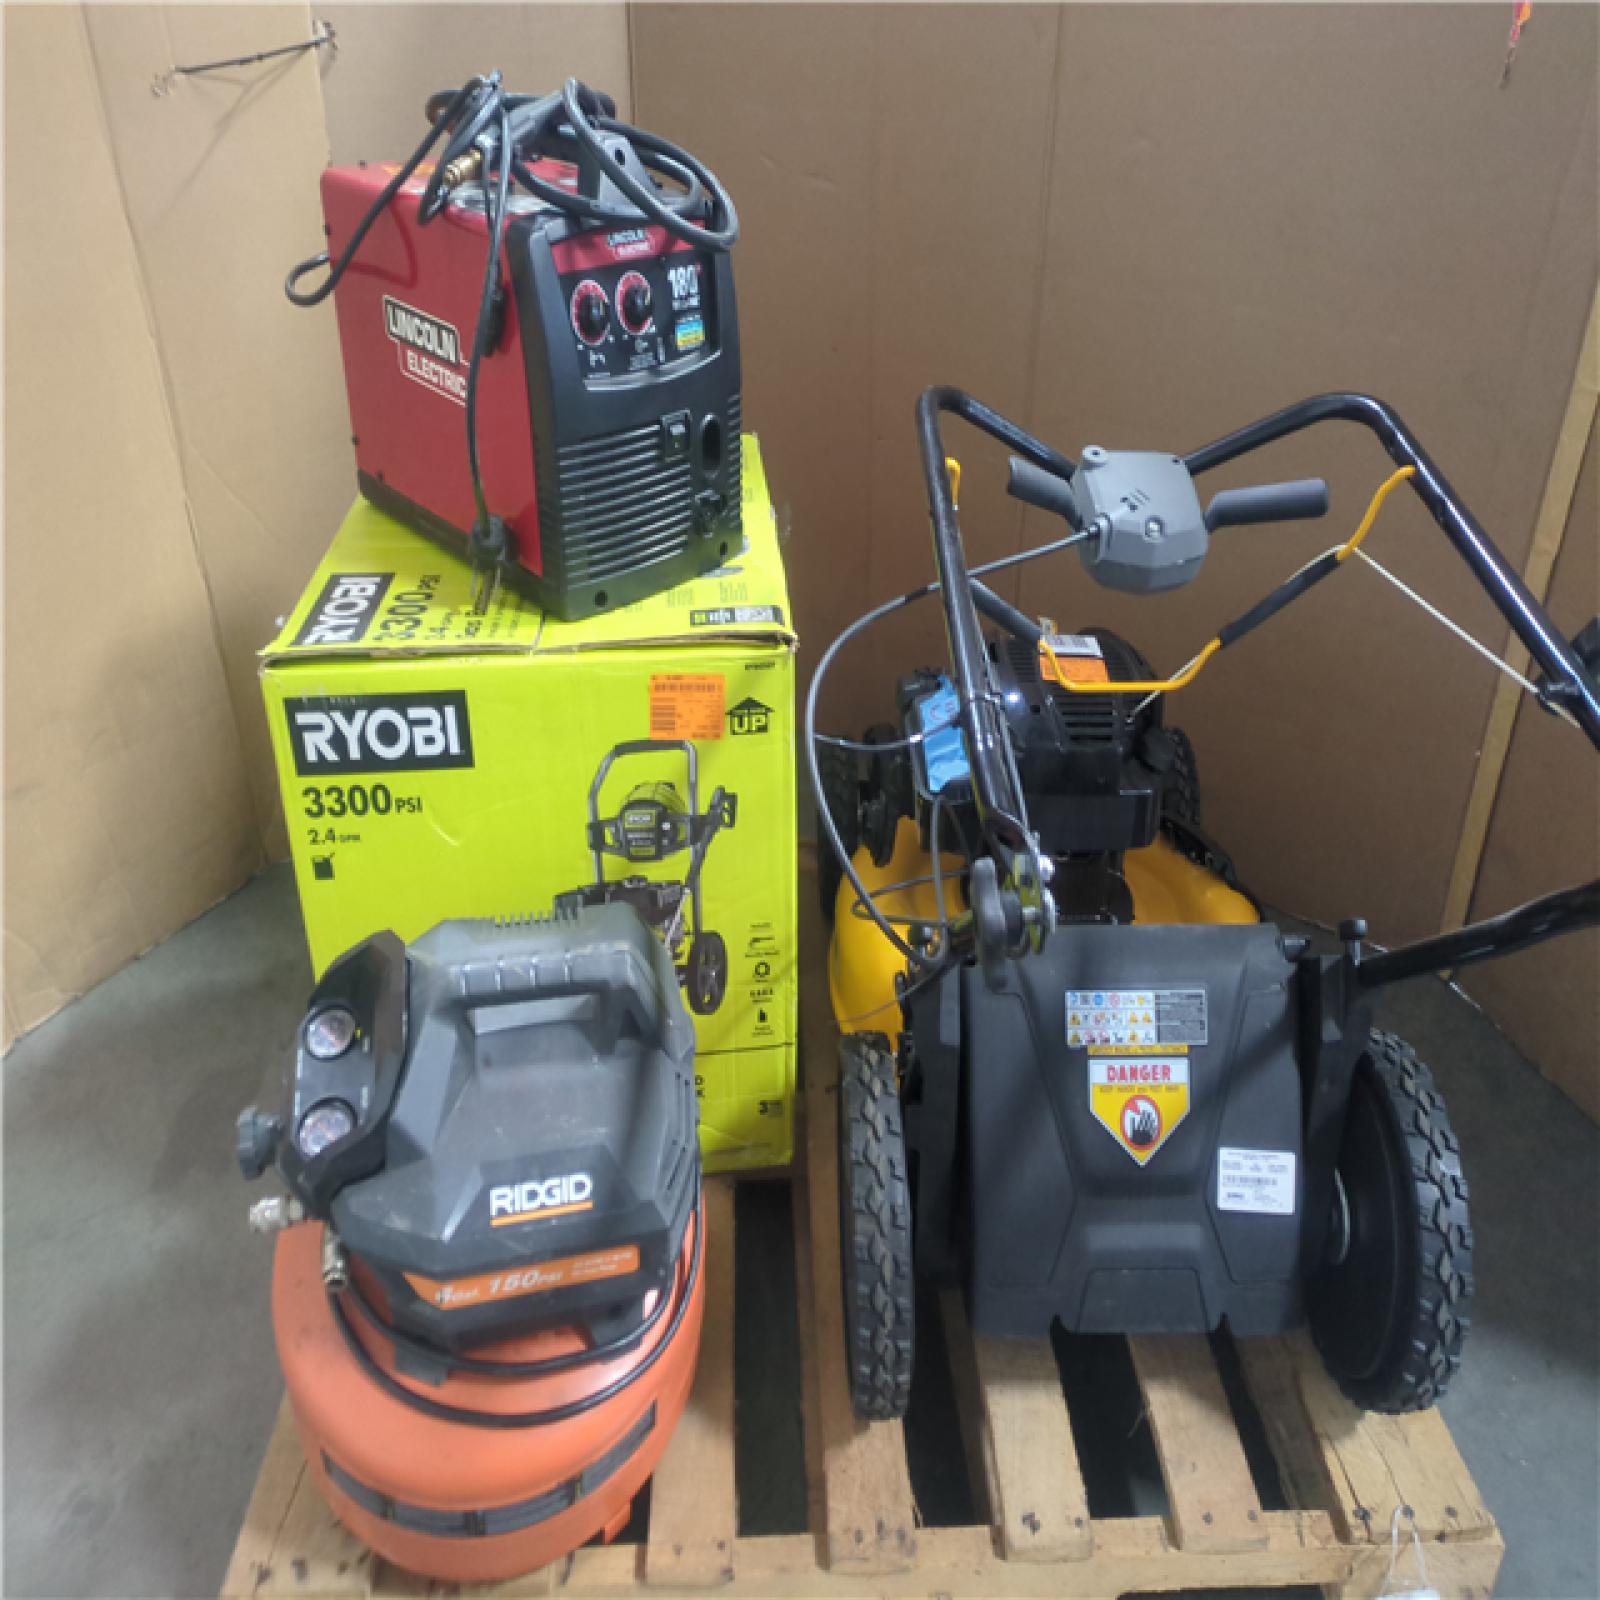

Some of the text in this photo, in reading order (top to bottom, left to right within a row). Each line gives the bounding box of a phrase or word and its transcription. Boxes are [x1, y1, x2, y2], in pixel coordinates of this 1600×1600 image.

[386, 304, 457, 364] LINCOLN
[302, 576, 381, 645] RYOBI
[295, 704, 461, 763] RYOBI
[734, 714, 768, 734] UP
[302, 783, 424, 818] 3300 PSI
[307, 827, 336, 846] 2.4
[1107, 1064, 1171, 1081] DANGER
[490, 1171, 593, 1217] RIDGID
